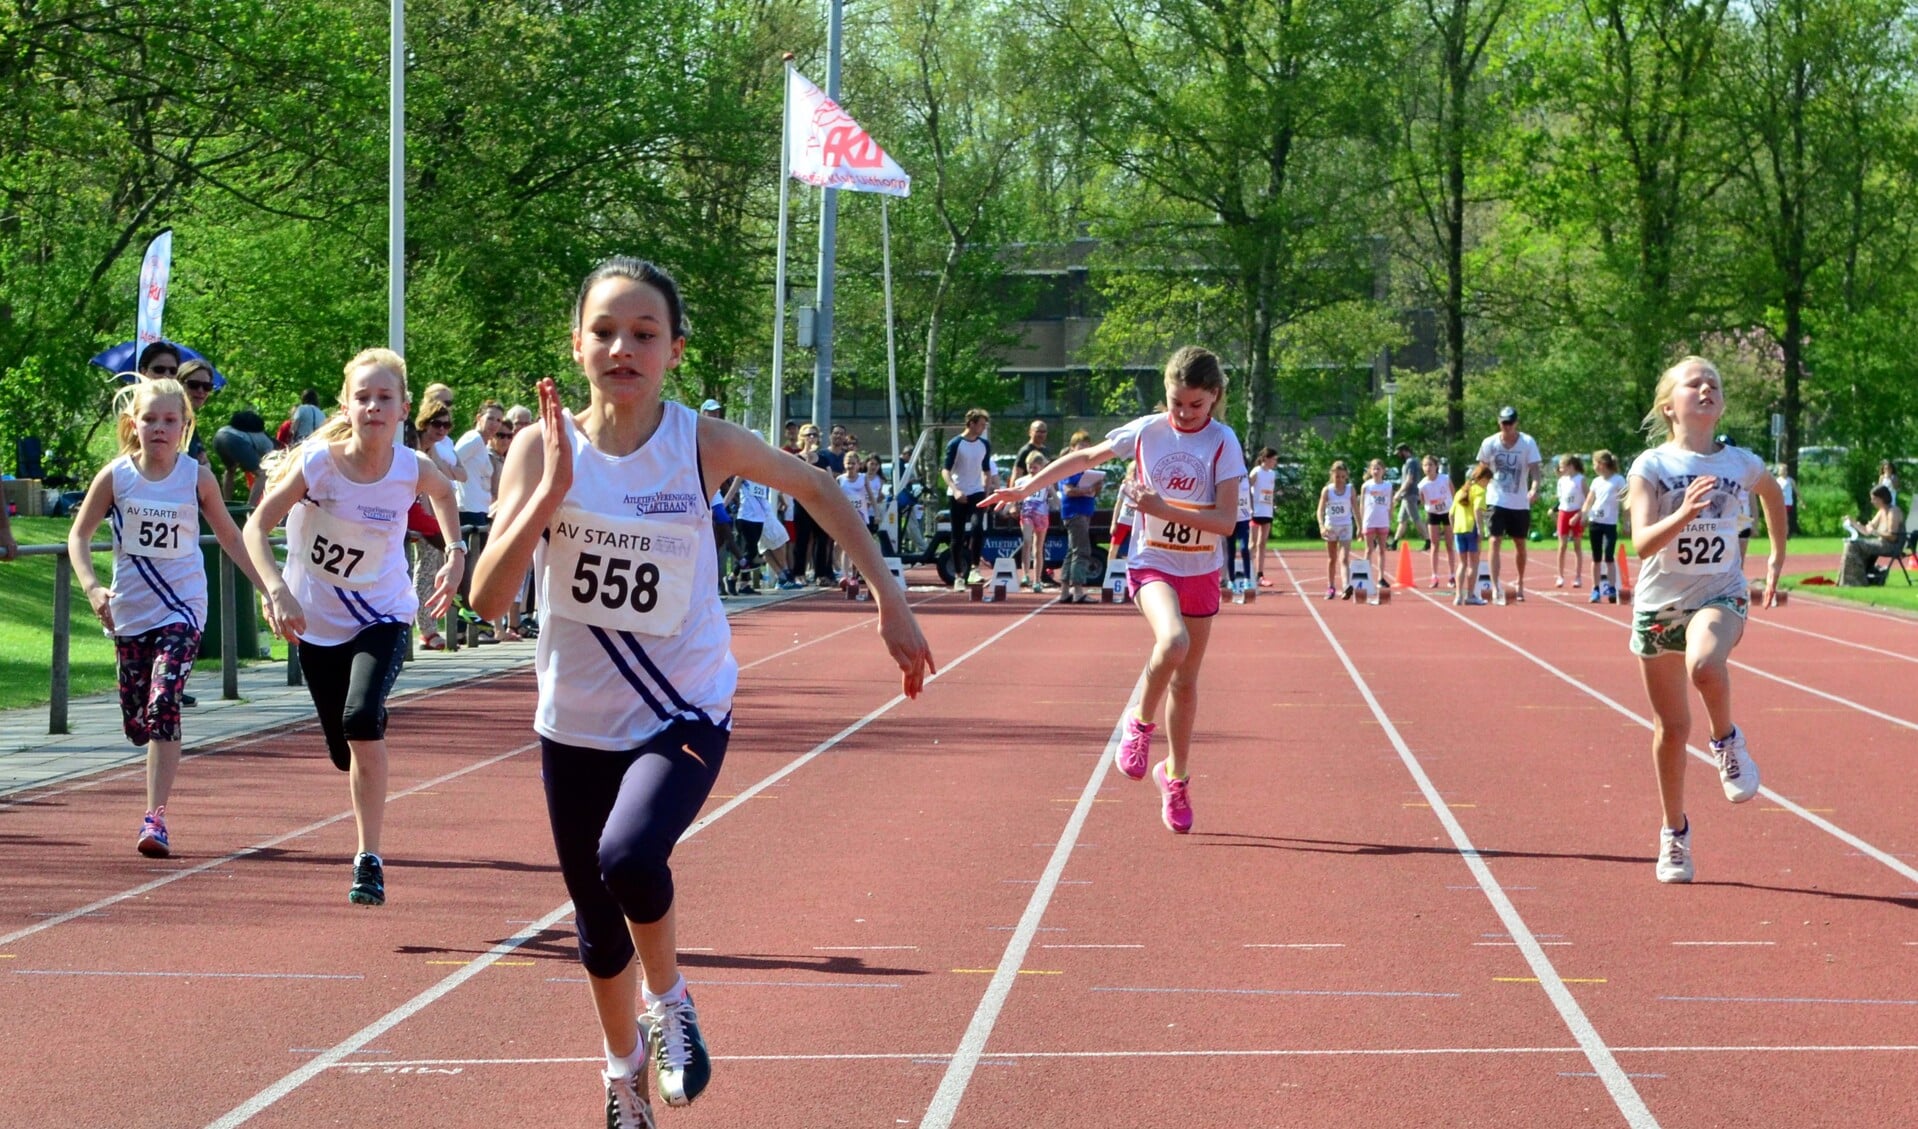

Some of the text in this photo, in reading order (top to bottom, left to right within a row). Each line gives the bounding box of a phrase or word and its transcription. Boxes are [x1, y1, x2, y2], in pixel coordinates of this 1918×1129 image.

[127, 506, 140, 515] AV
[139, 521, 179, 549] 521
[556, 522, 580, 540] AV
[311, 534, 365, 578] 527
[1678, 536, 1725, 565] 522
[571, 552, 660, 613] 558
[1114, 580, 1121, 592] 6
